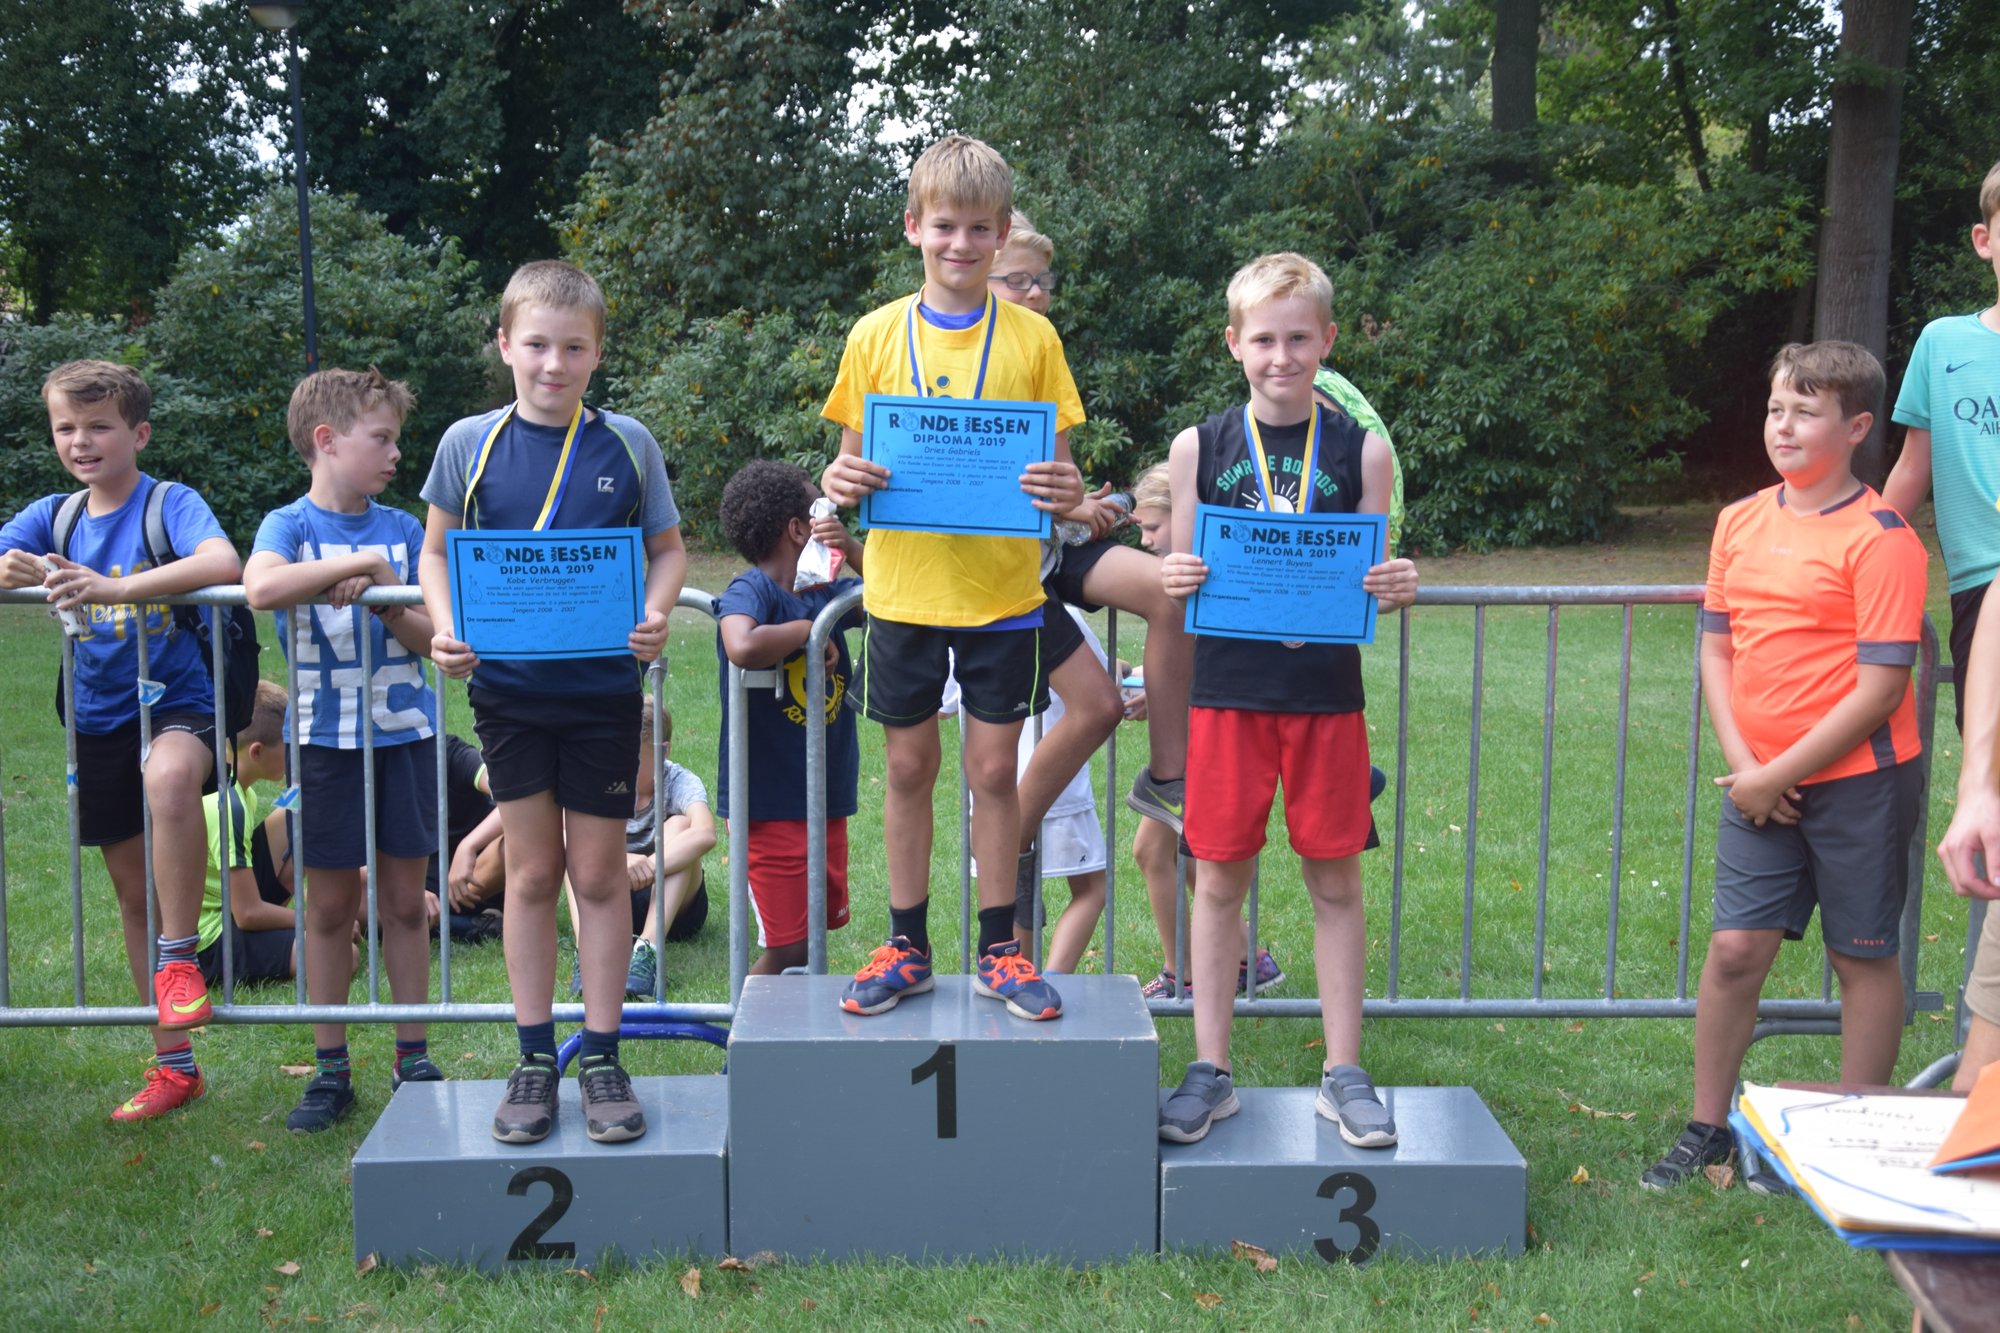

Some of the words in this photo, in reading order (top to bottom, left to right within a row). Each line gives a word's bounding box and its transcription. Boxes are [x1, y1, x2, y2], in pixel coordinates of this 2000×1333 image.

[889, 409, 958, 432] RONDE
[971, 417, 1030, 435] ESSEN
[1953, 395, 2000, 426] QA
[913, 434, 972, 446] DIPLOMA
[978, 437, 1006, 447] 2019
[924, 446, 945, 455] Dries
[948, 447, 981, 456] Gabriels
[1216, 455, 1276, 491] SUNRE
[1220, 521, 1290, 544] RONDE
[1303, 529, 1361, 546] ESSEN
[473, 543, 545, 564] RONDE
[558, 545, 617, 562] ESSEN
[1244, 545, 1303, 557] DIPLOMA
[1309, 549, 1337, 558] 2019
[1252, 557, 1283, 566] Lennert
[500, 565, 560, 574] DIPLOMA
[566, 564, 594, 574] 2019
[530, 577, 576, 585] Verbruggen
[911, 1044, 957, 1138] 1
[507, 1166, 577, 1261] 2
[1315, 1172, 1380, 1264] 3
